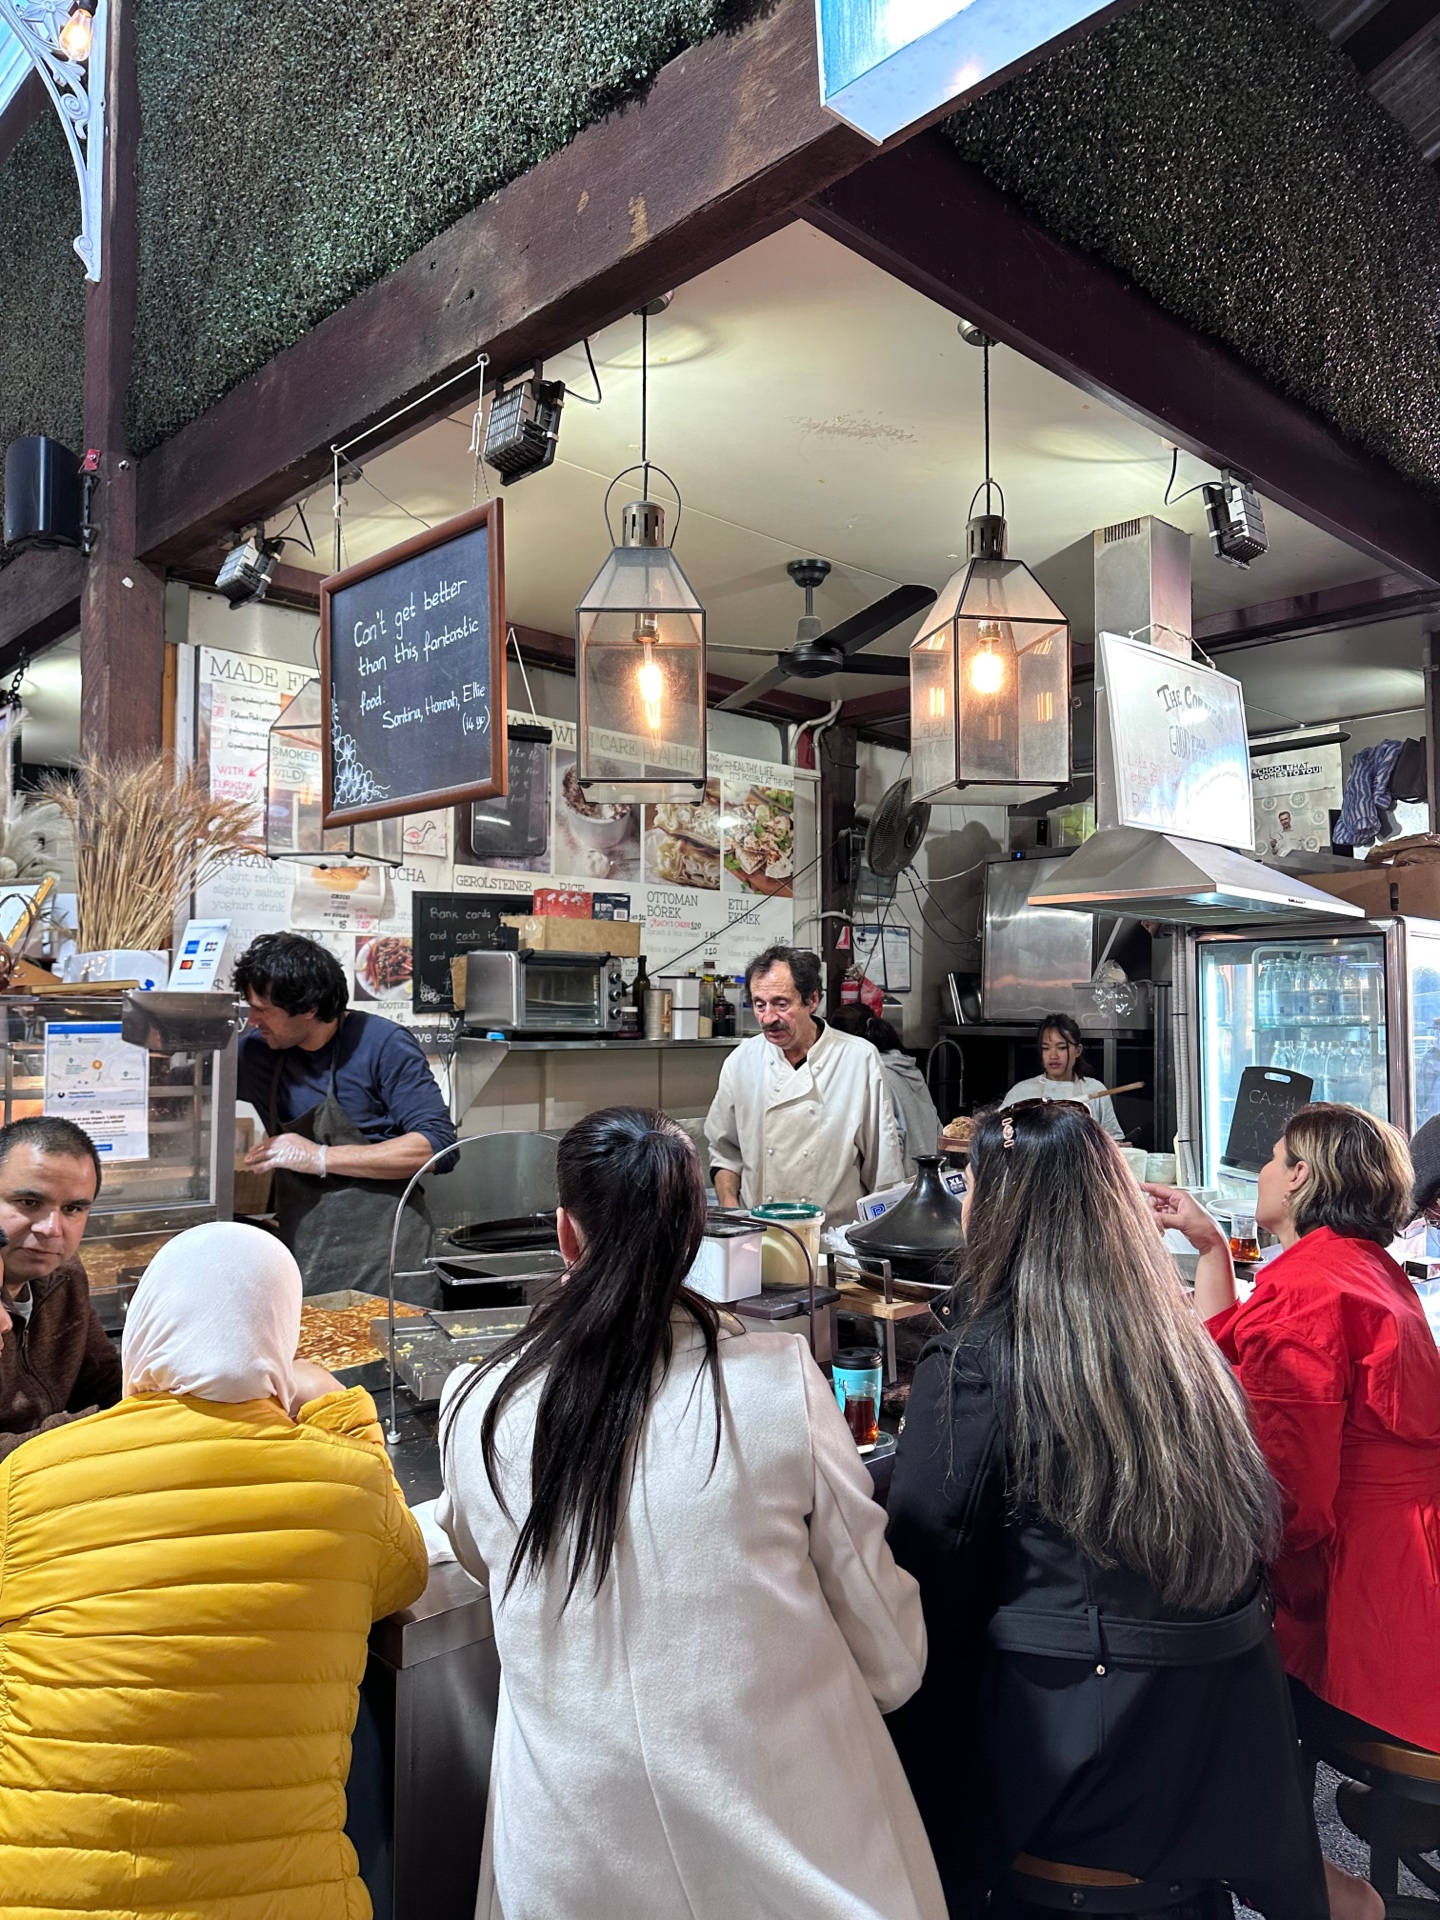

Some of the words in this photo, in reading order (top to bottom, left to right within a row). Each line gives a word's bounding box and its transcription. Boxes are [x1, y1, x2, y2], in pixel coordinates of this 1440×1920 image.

[353, 609, 387, 647] Can't
[395, 592, 416, 640] get
[424, 580, 468, 611] better
[358, 656, 387, 676] than
[394, 642, 418, 664] this,
[423, 615, 479, 662] fantastic
[210, 656, 279, 688] MADE
[360, 685, 386, 716] food.
[382, 708, 423, 729] Santina,
[425, 690, 460, 716] Hannah,
[463, 681, 485, 702] Ellie
[1157, 684, 1182, 712] THE
[271, 746, 320, 763] SMOKED
[642, 741, 697, 769] HEALTHY
[217, 766, 244, 775] WITH
[760, 766, 774, 777] LIFE
[1258, 771, 1287, 781] COMES
[1301, 766, 1323, 775] YOU!
[1288, 762, 1309, 770] THAT
[387, 867, 426, 882] UCHA
[456, 874, 532, 892] GEROLSTEINER
[212, 884, 252, 900] slightly
[254, 888, 286, 899] salted
[647, 891, 699, 906] OTTOMAN
[211, 899, 254, 912] yoghurt
[647, 904, 682, 919] BÖREK
[728, 898, 750, 911] ETLI
[430, 907, 459, 919] Bank
[465, 908, 491, 918] cards
[728, 911, 761, 926] EKMEK
[429, 929, 447, 941] and
[455, 929, 480, 941] cash
[1249, 1089, 1296, 1111] CASH
[948, 1177, 963, 1187] XL
